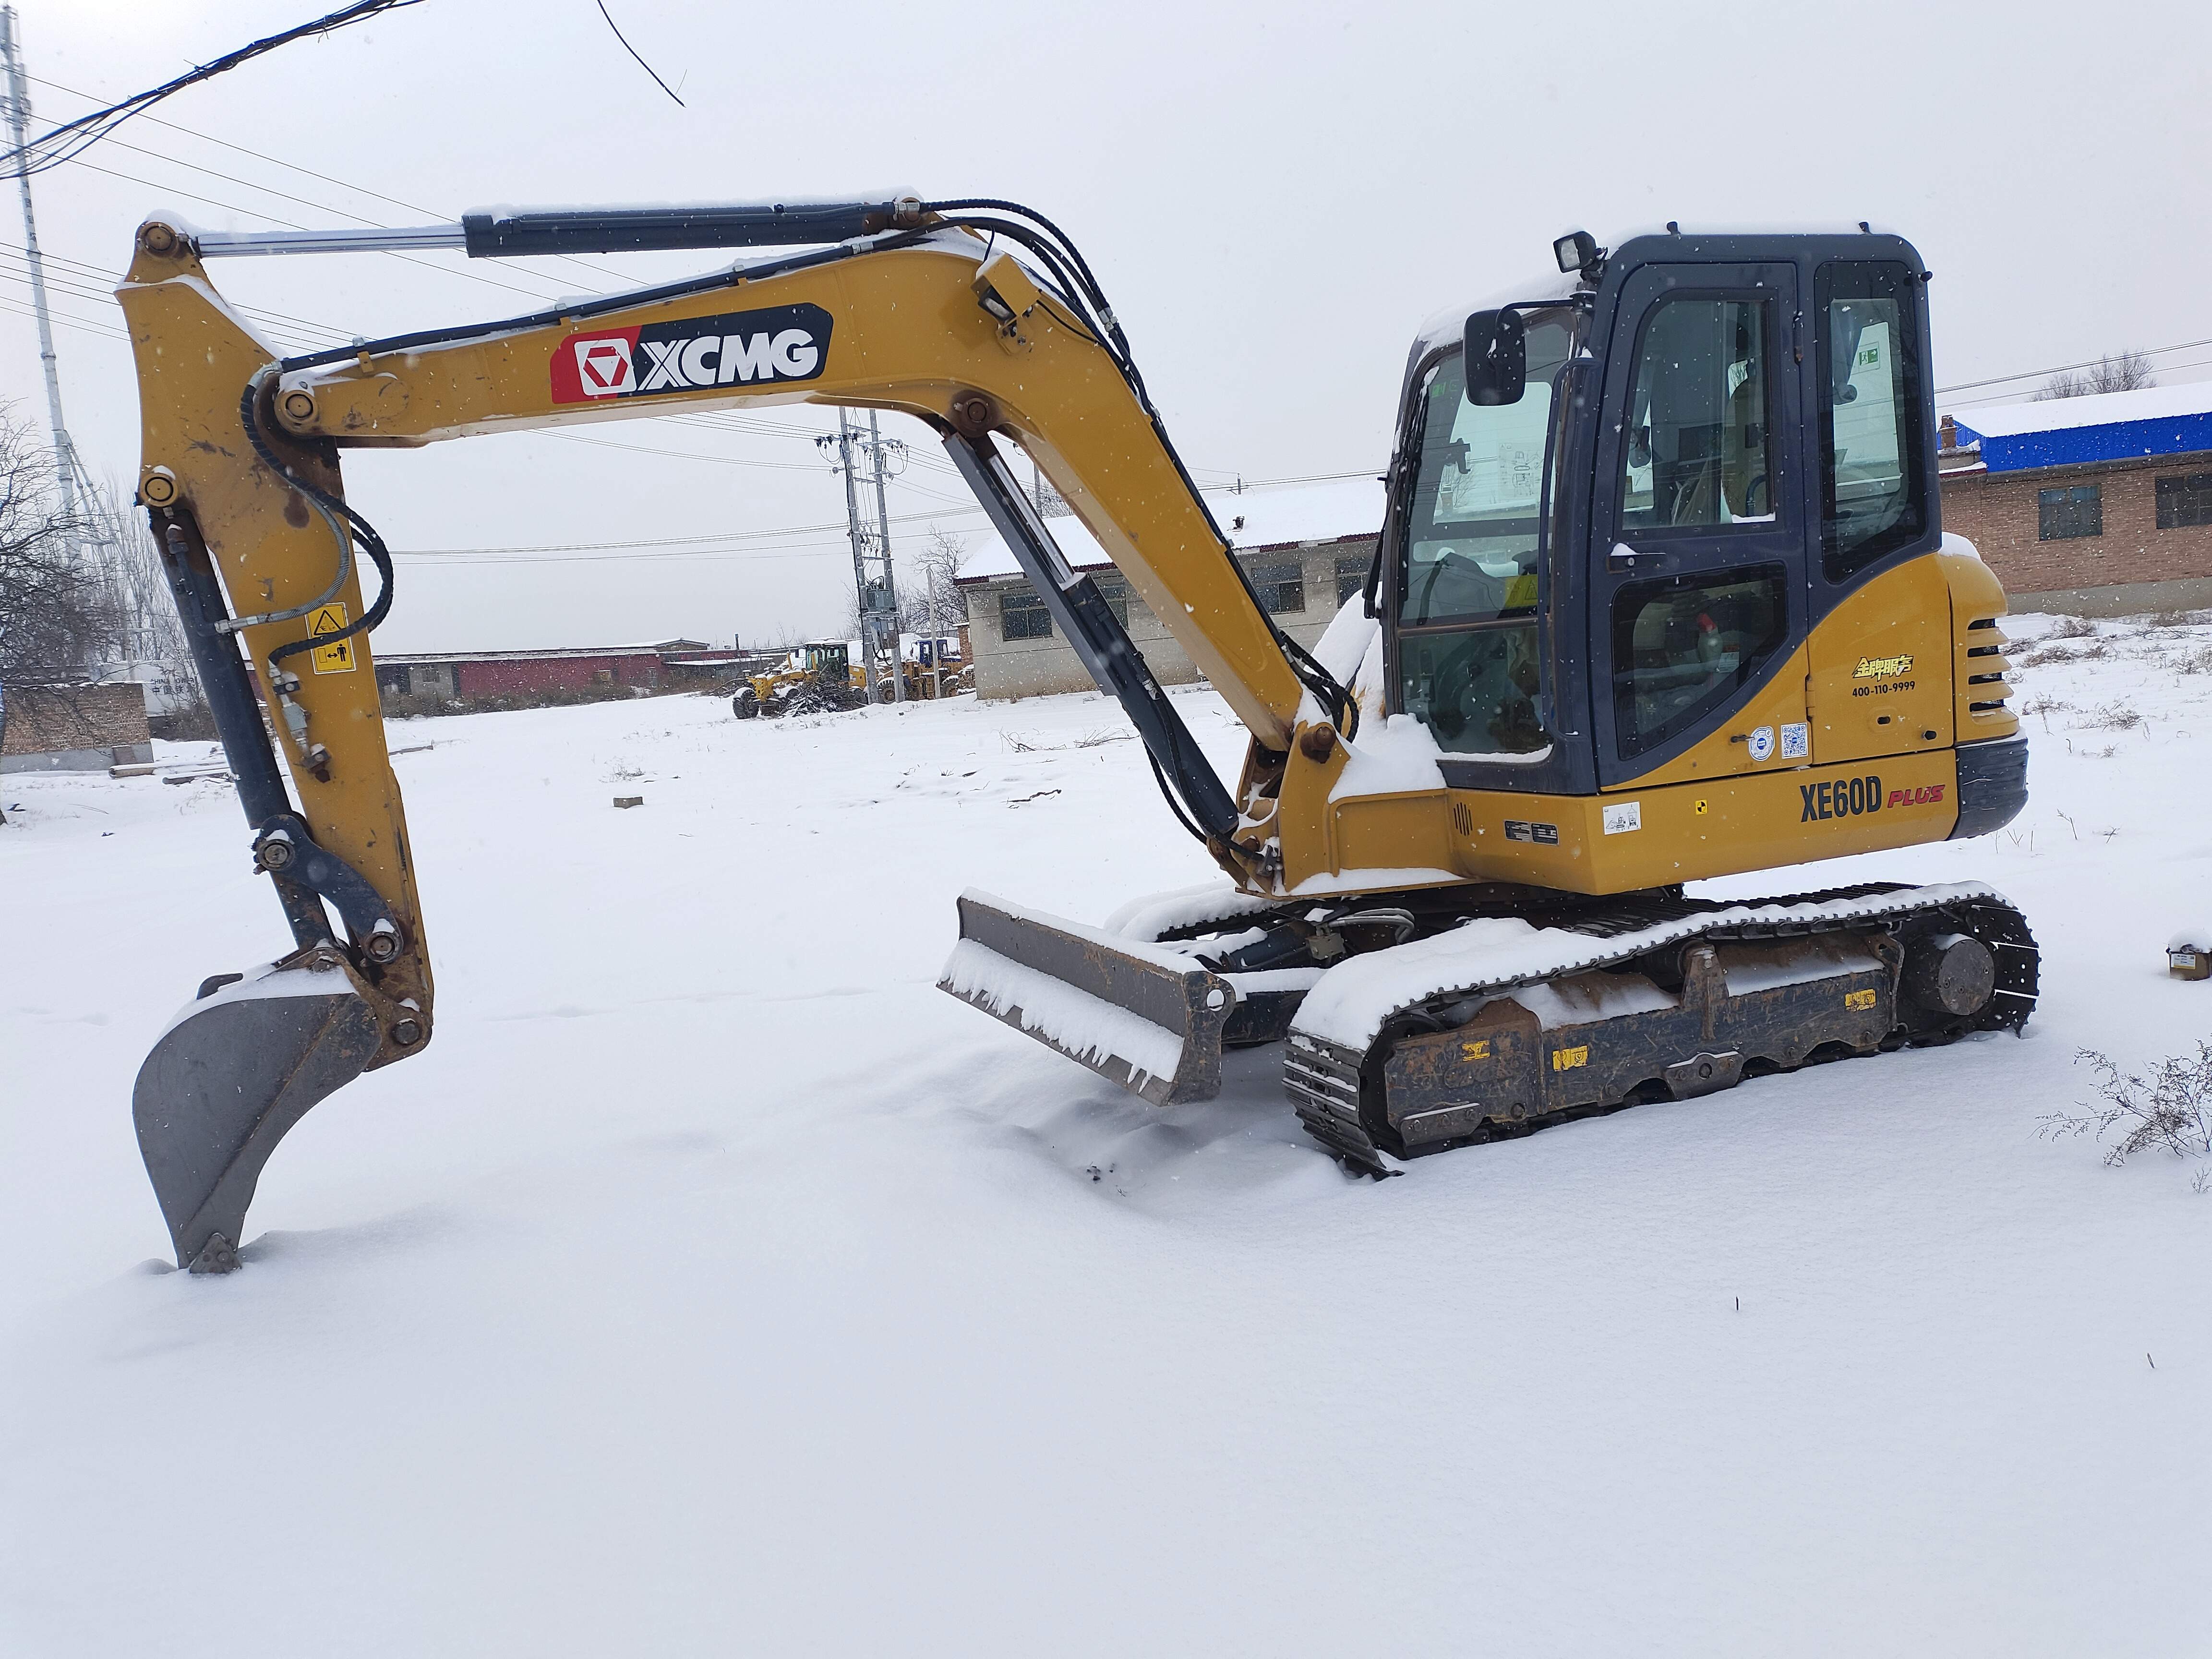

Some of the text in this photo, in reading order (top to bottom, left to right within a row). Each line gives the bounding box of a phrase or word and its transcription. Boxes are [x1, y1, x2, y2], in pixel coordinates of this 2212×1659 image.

[637, 329, 818, 391] XCMG
[1852, 654, 1914, 682] 金牌服务
[1852, 681, 1915, 697] 400-110-9999
[1800, 776, 1946, 822] XE60D PLUS
